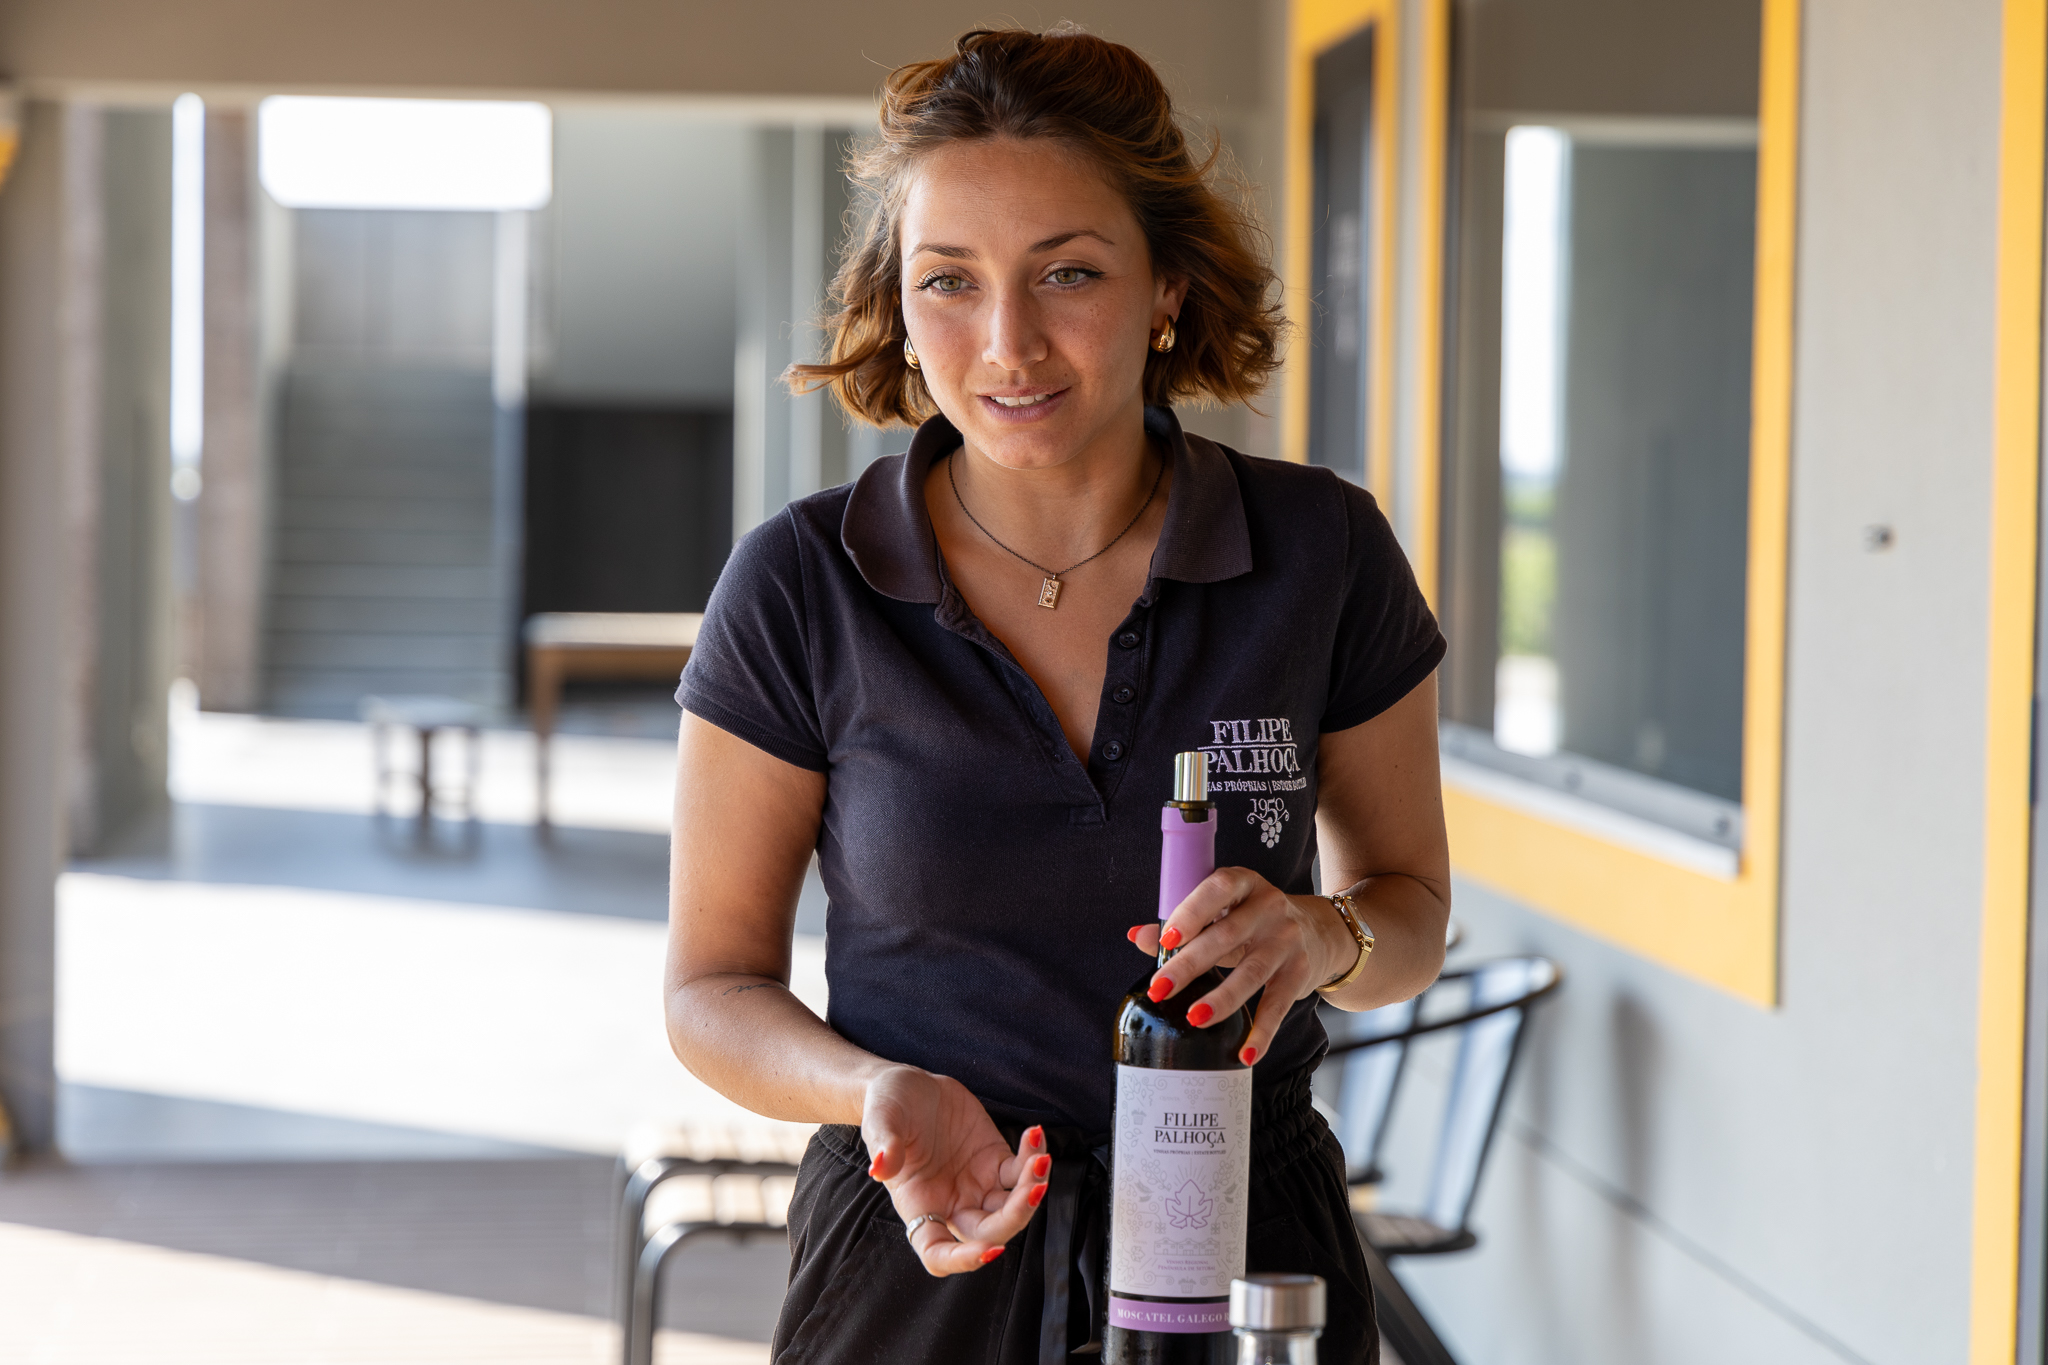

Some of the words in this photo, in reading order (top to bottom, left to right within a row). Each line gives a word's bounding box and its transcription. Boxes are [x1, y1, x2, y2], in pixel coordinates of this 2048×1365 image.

[1210, 718, 1293, 744] FILIPE
[1207, 748, 1301, 778] PALHOÇA
[1224, 779, 1268, 792] PRÓPRIAS
[1250, 797, 1285, 825] 1950
[1163, 1112, 1219, 1128] FILIPE
[1154, 1130, 1226, 1148] PALHOÇA
[1117, 1308, 1175, 1323] MOSCATEL
[1177, 1313, 1223, 1324] GALEGO
